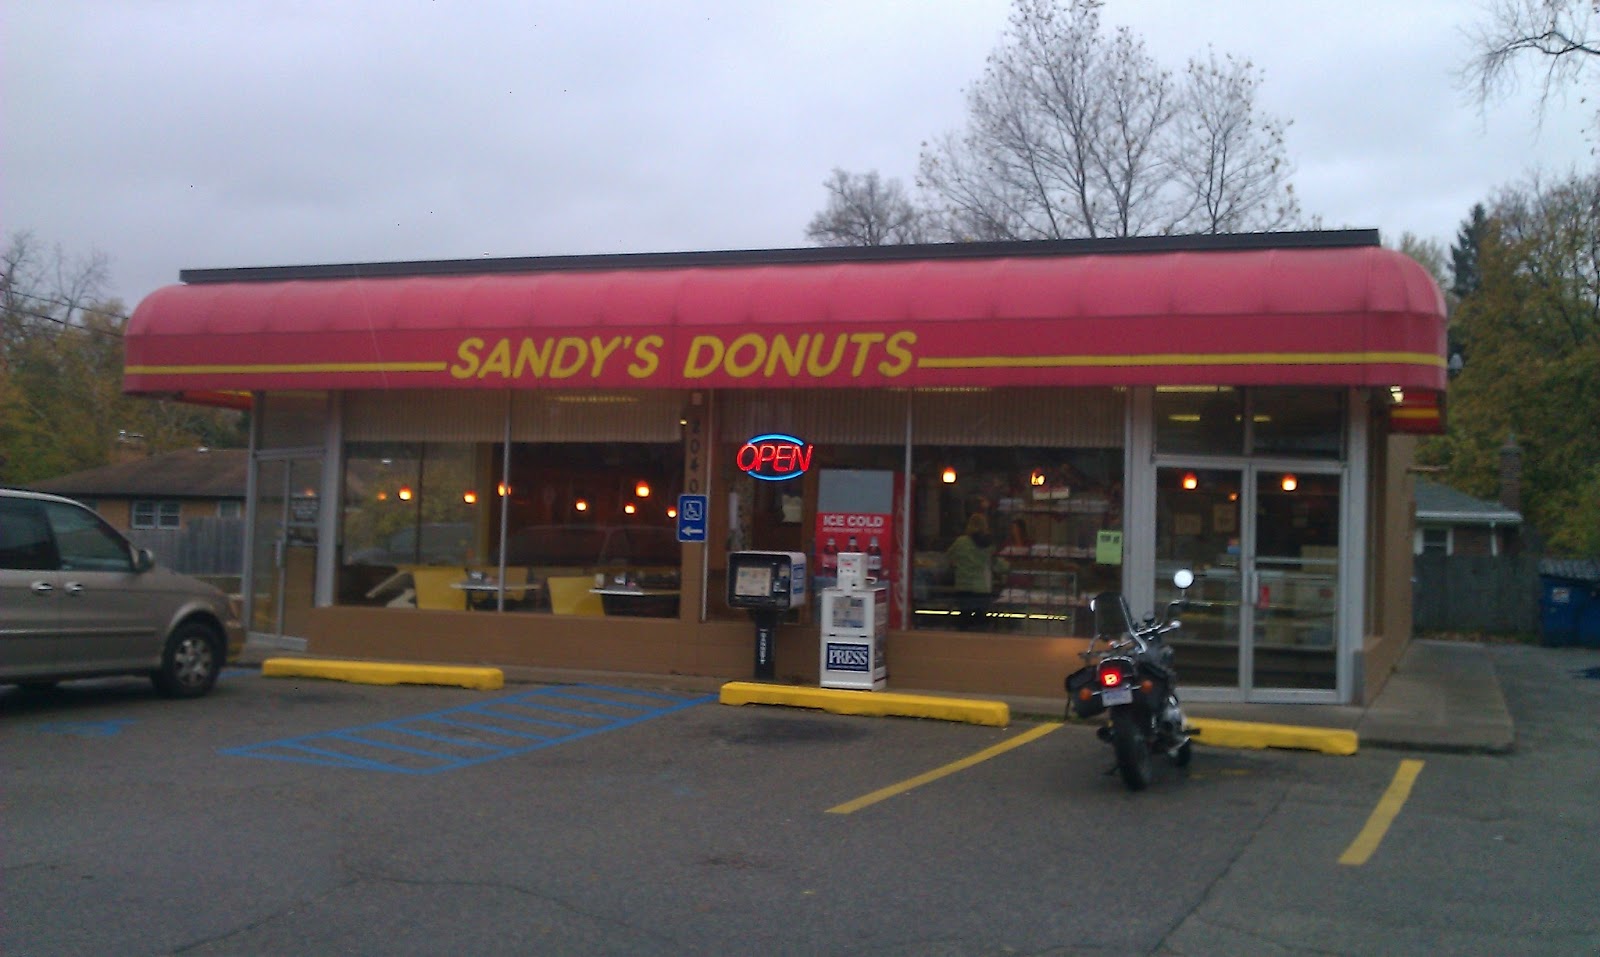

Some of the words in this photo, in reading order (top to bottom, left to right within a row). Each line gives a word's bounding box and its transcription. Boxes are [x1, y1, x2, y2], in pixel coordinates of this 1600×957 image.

[450, 334, 664, 379] SANDY'S
[683, 330, 918, 379] DONUTS
[736, 444, 814, 472] OPEN
[823, 514, 845, 526] ICE
[847, 514, 884, 528] COLD
[828, 649, 868, 665] PRESS
